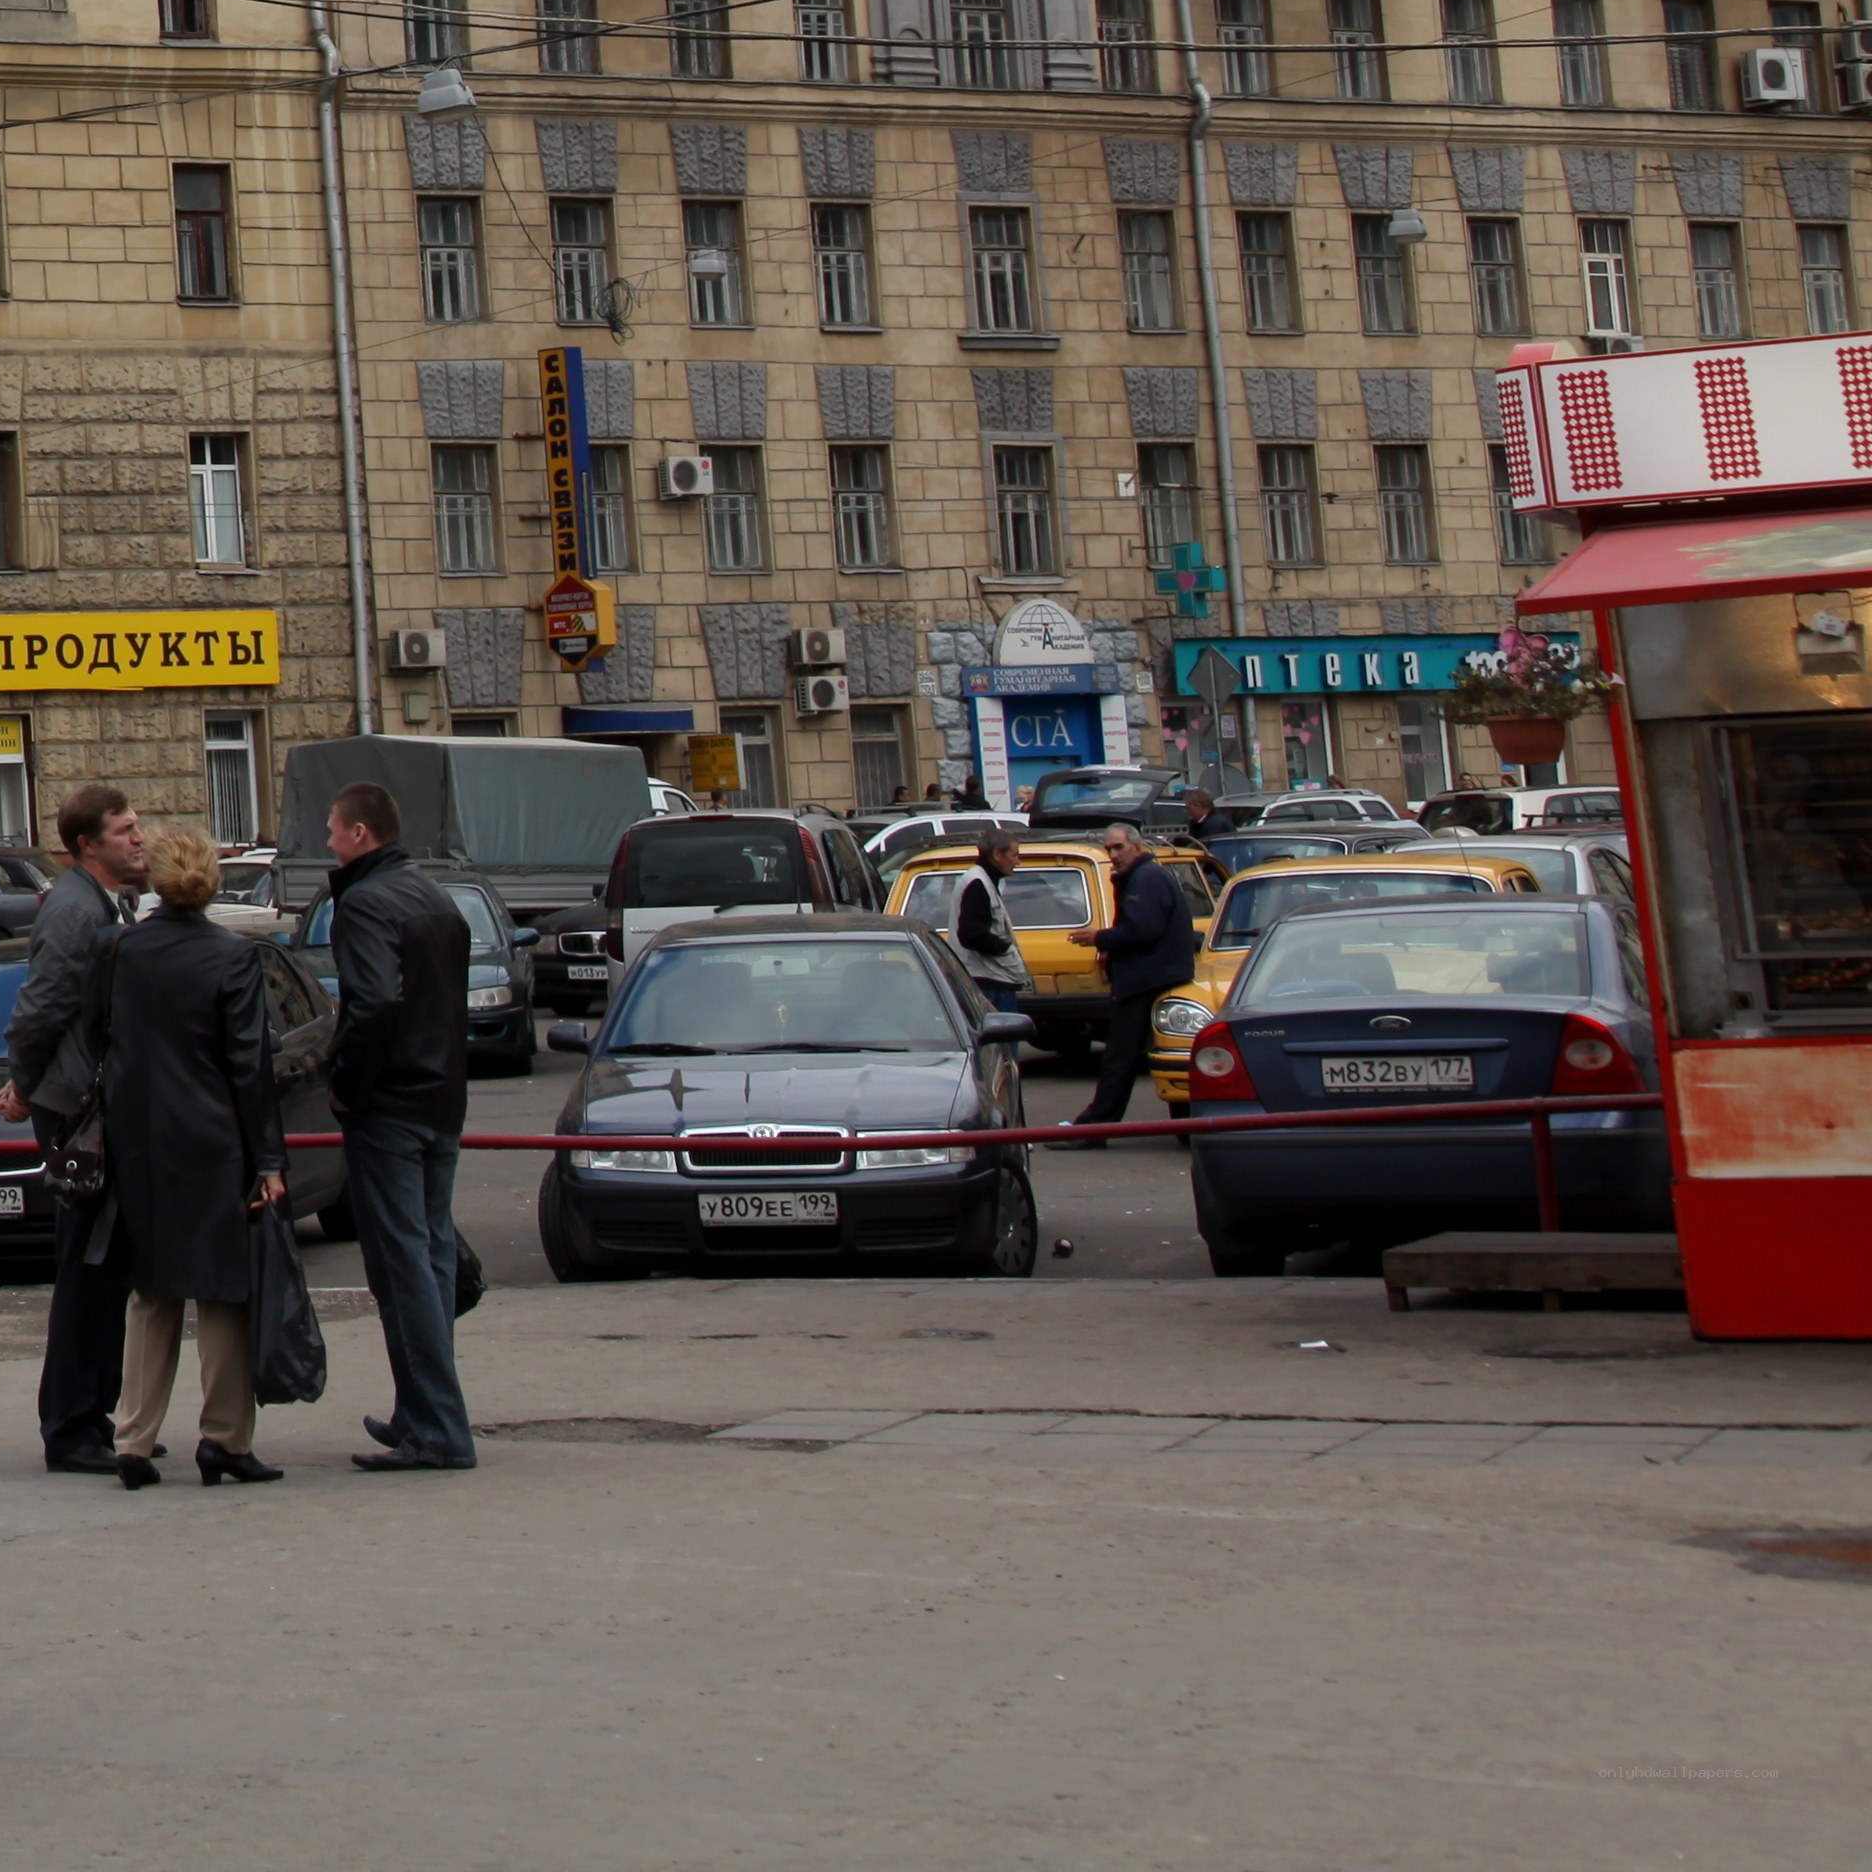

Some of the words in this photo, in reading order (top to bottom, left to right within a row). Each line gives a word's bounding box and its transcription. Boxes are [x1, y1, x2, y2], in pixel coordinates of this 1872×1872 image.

[544, 354, 569, 460] САЛОН
[553, 467, 577, 573] СВЯЗИ
[1241, 650, 1421, 689] птека
[1011, 714, 1074, 748] СГА
[1244, 1030, 1285, 1038] FOCUS
[1330, 1061, 1423, 1084] М832ВУ
[1430, 1057, 1464, 1077] 177
[706, 1196, 793, 1218] У809ЕЕ
[799, 1194, 831, 1211] 199
